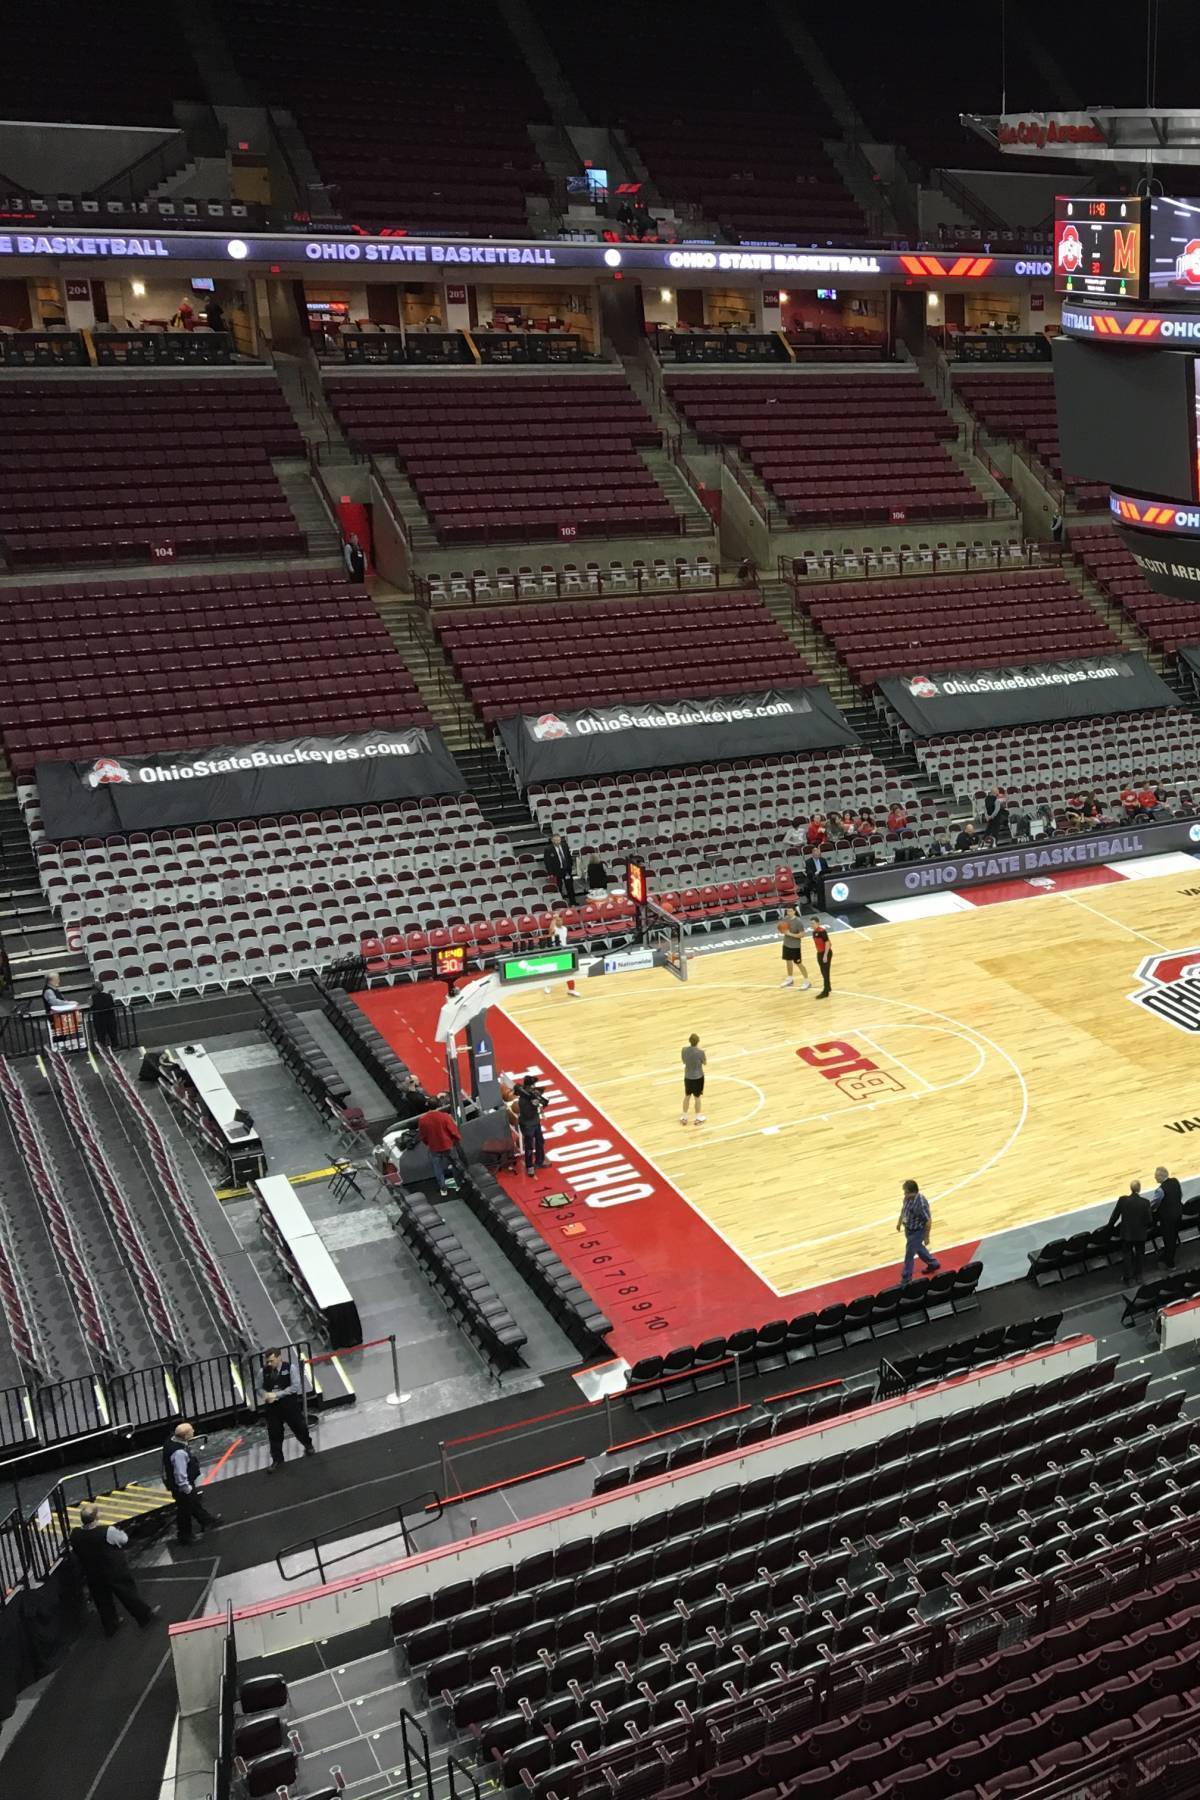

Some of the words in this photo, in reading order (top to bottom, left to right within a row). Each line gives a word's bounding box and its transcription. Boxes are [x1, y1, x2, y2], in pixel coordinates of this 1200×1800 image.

[17, 236, 168, 256] BASKETBALL
[306, 243, 361, 260] OHIO
[365, 245, 427, 261] STATE
[431, 246, 556, 264] BASKETBALL
[669, 251, 717, 268] OHIO
[718, 253, 772, 270] STATE
[774, 254, 880, 272] BASKETBALL
[1014, 261, 1052, 275] OHIO
[68, 286, 88, 295] 204
[561, 527, 576, 536] 105
[155, 547, 173, 557] 104
[1149, 558, 1168, 576] CITY
[942, 666, 1119, 695] OhioStateBuckeyes.com
[575, 701, 793, 734] OhioStateBuckeyes.com
[138, 743, 411, 783] OhioStateBuckeyes.com
[905, 867, 957, 889] OHIO
[962, 858, 1019, 880] STATE
[1025, 836, 1143, 871] BASKETBALL
[441, 959, 460, 975] 30
[546, 1138, 655, 1209] OHIO
[556, 1211, 575, 1222] 3
[580, 1238, 600, 1249] 5
[592, 1254, 613, 1265] 6
[605, 1268, 626, 1279] 7
[618, 1285, 639, 1296] 8
[632, 1300, 653, 1311] 9
[648, 1315, 669, 1331] 10
